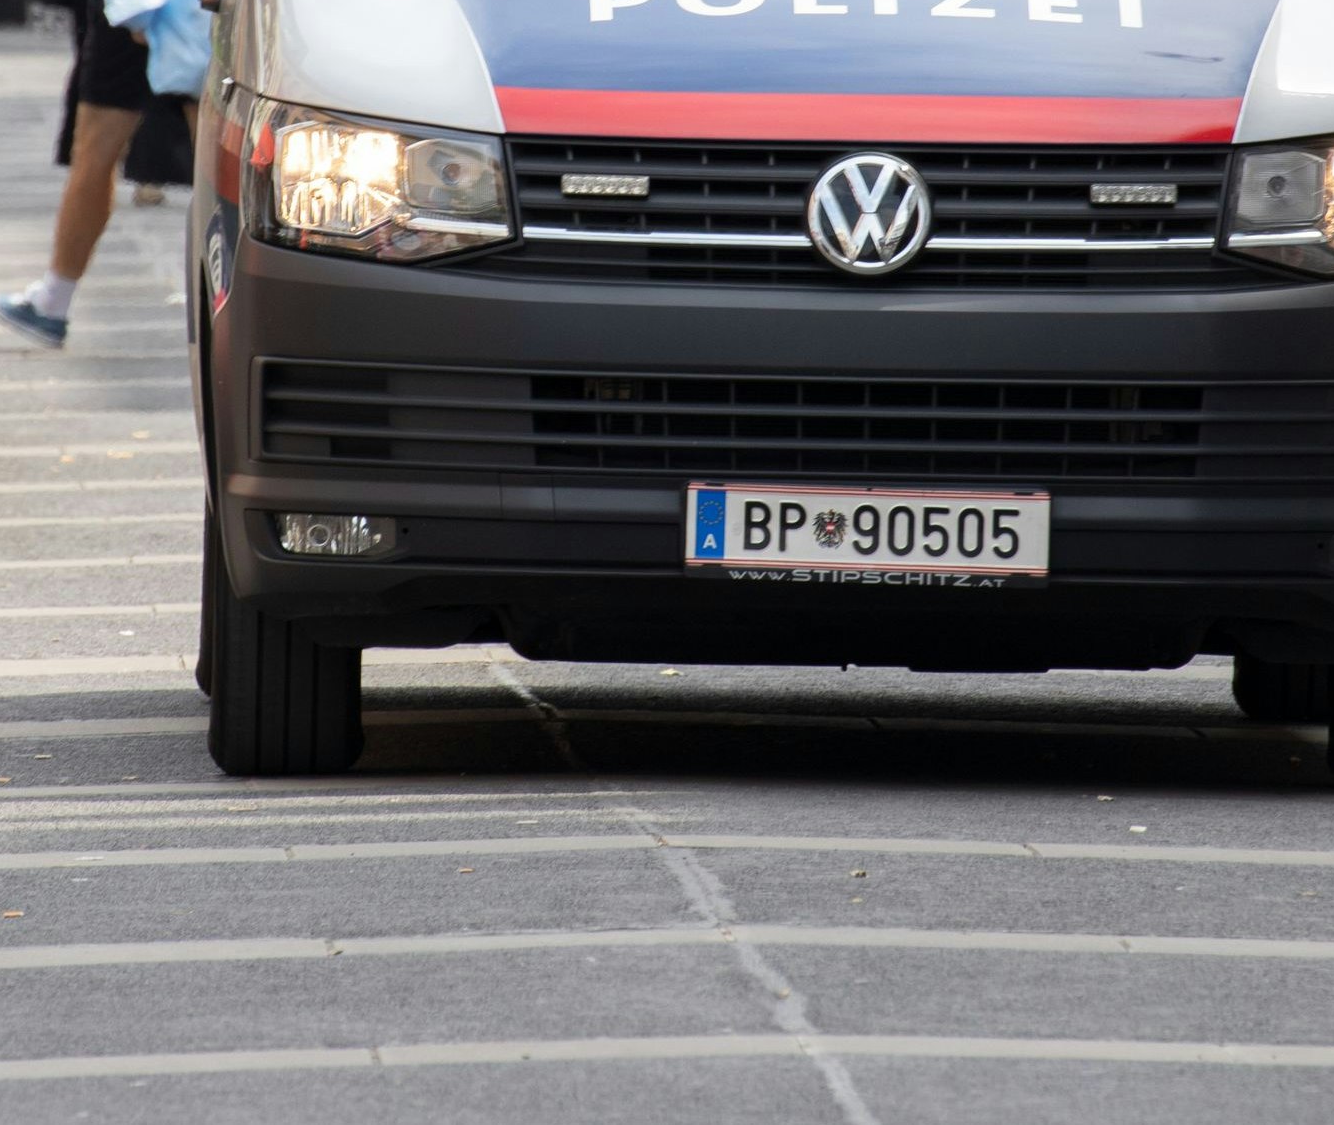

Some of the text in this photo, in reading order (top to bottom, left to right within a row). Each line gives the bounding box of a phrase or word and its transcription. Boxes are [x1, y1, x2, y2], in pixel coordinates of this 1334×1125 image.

[702, 533, 718, 550] A
[743, 500, 1021, 560] BP 90505
